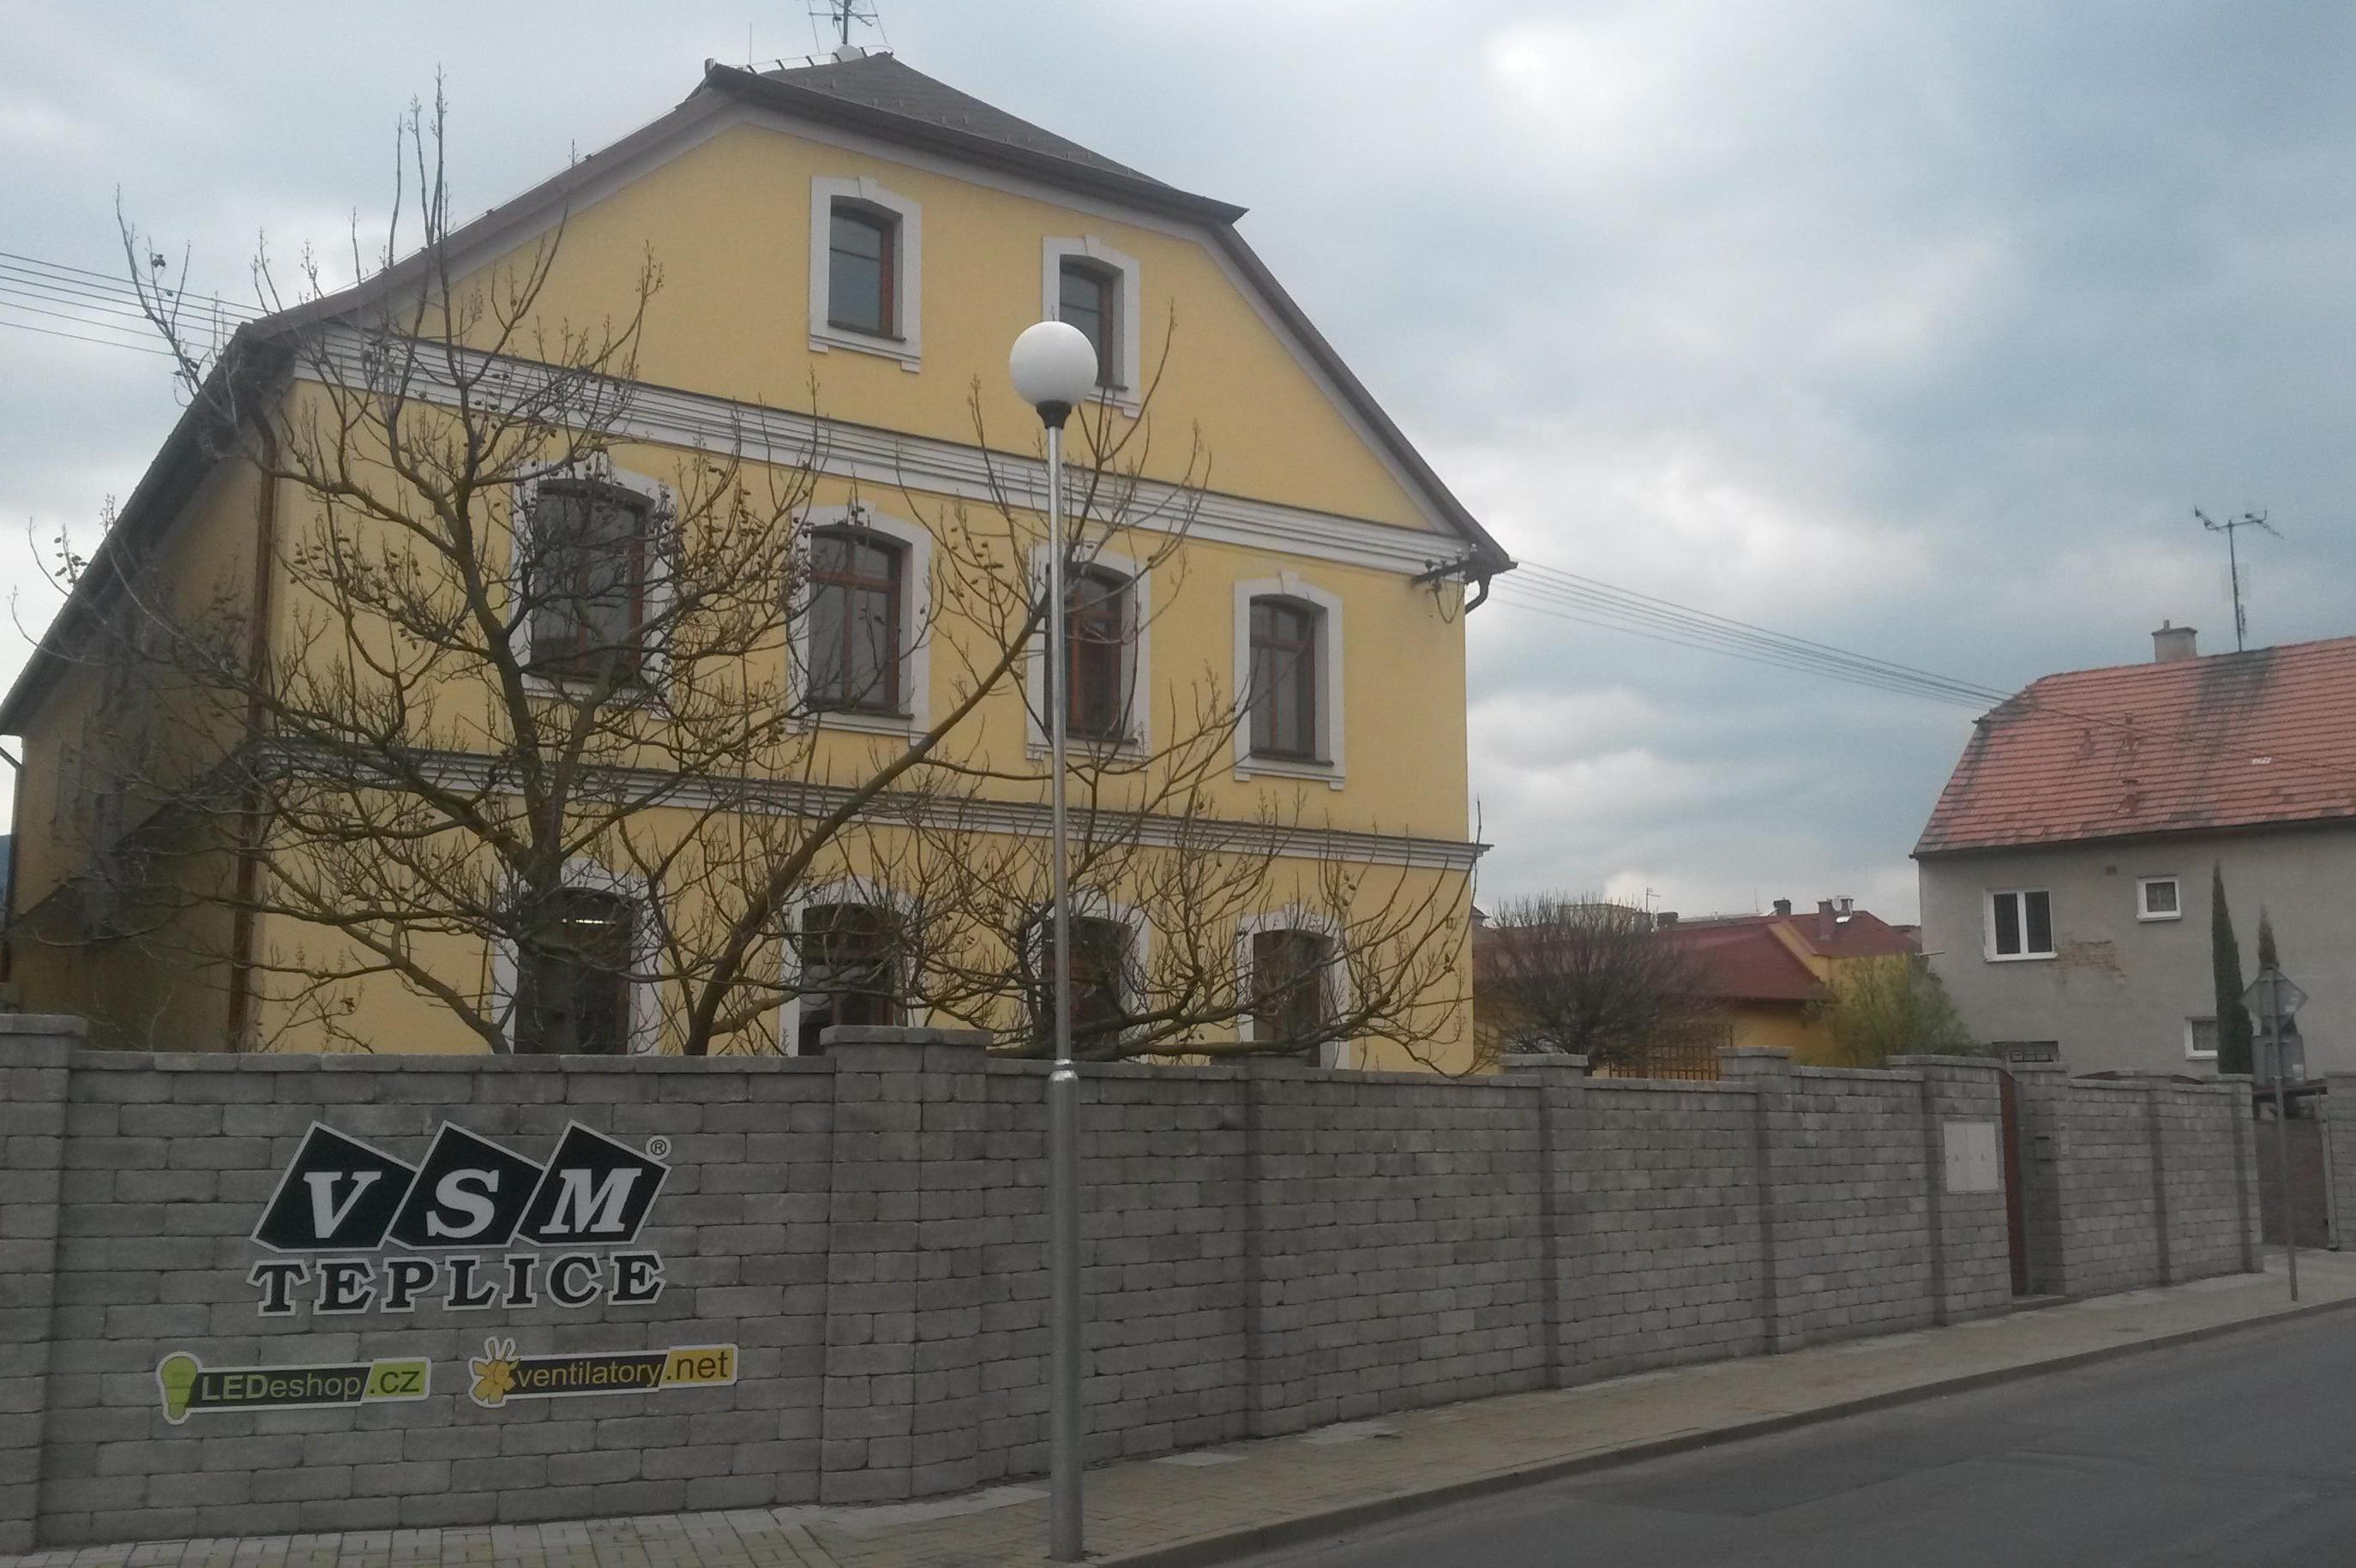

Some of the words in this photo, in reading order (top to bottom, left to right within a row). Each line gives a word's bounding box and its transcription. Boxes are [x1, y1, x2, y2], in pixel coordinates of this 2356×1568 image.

[303, 1168, 643, 1240] VSM
[255, 1253, 664, 1313] TEPLICE
[517, 1350, 729, 1388] ventilatory.net
